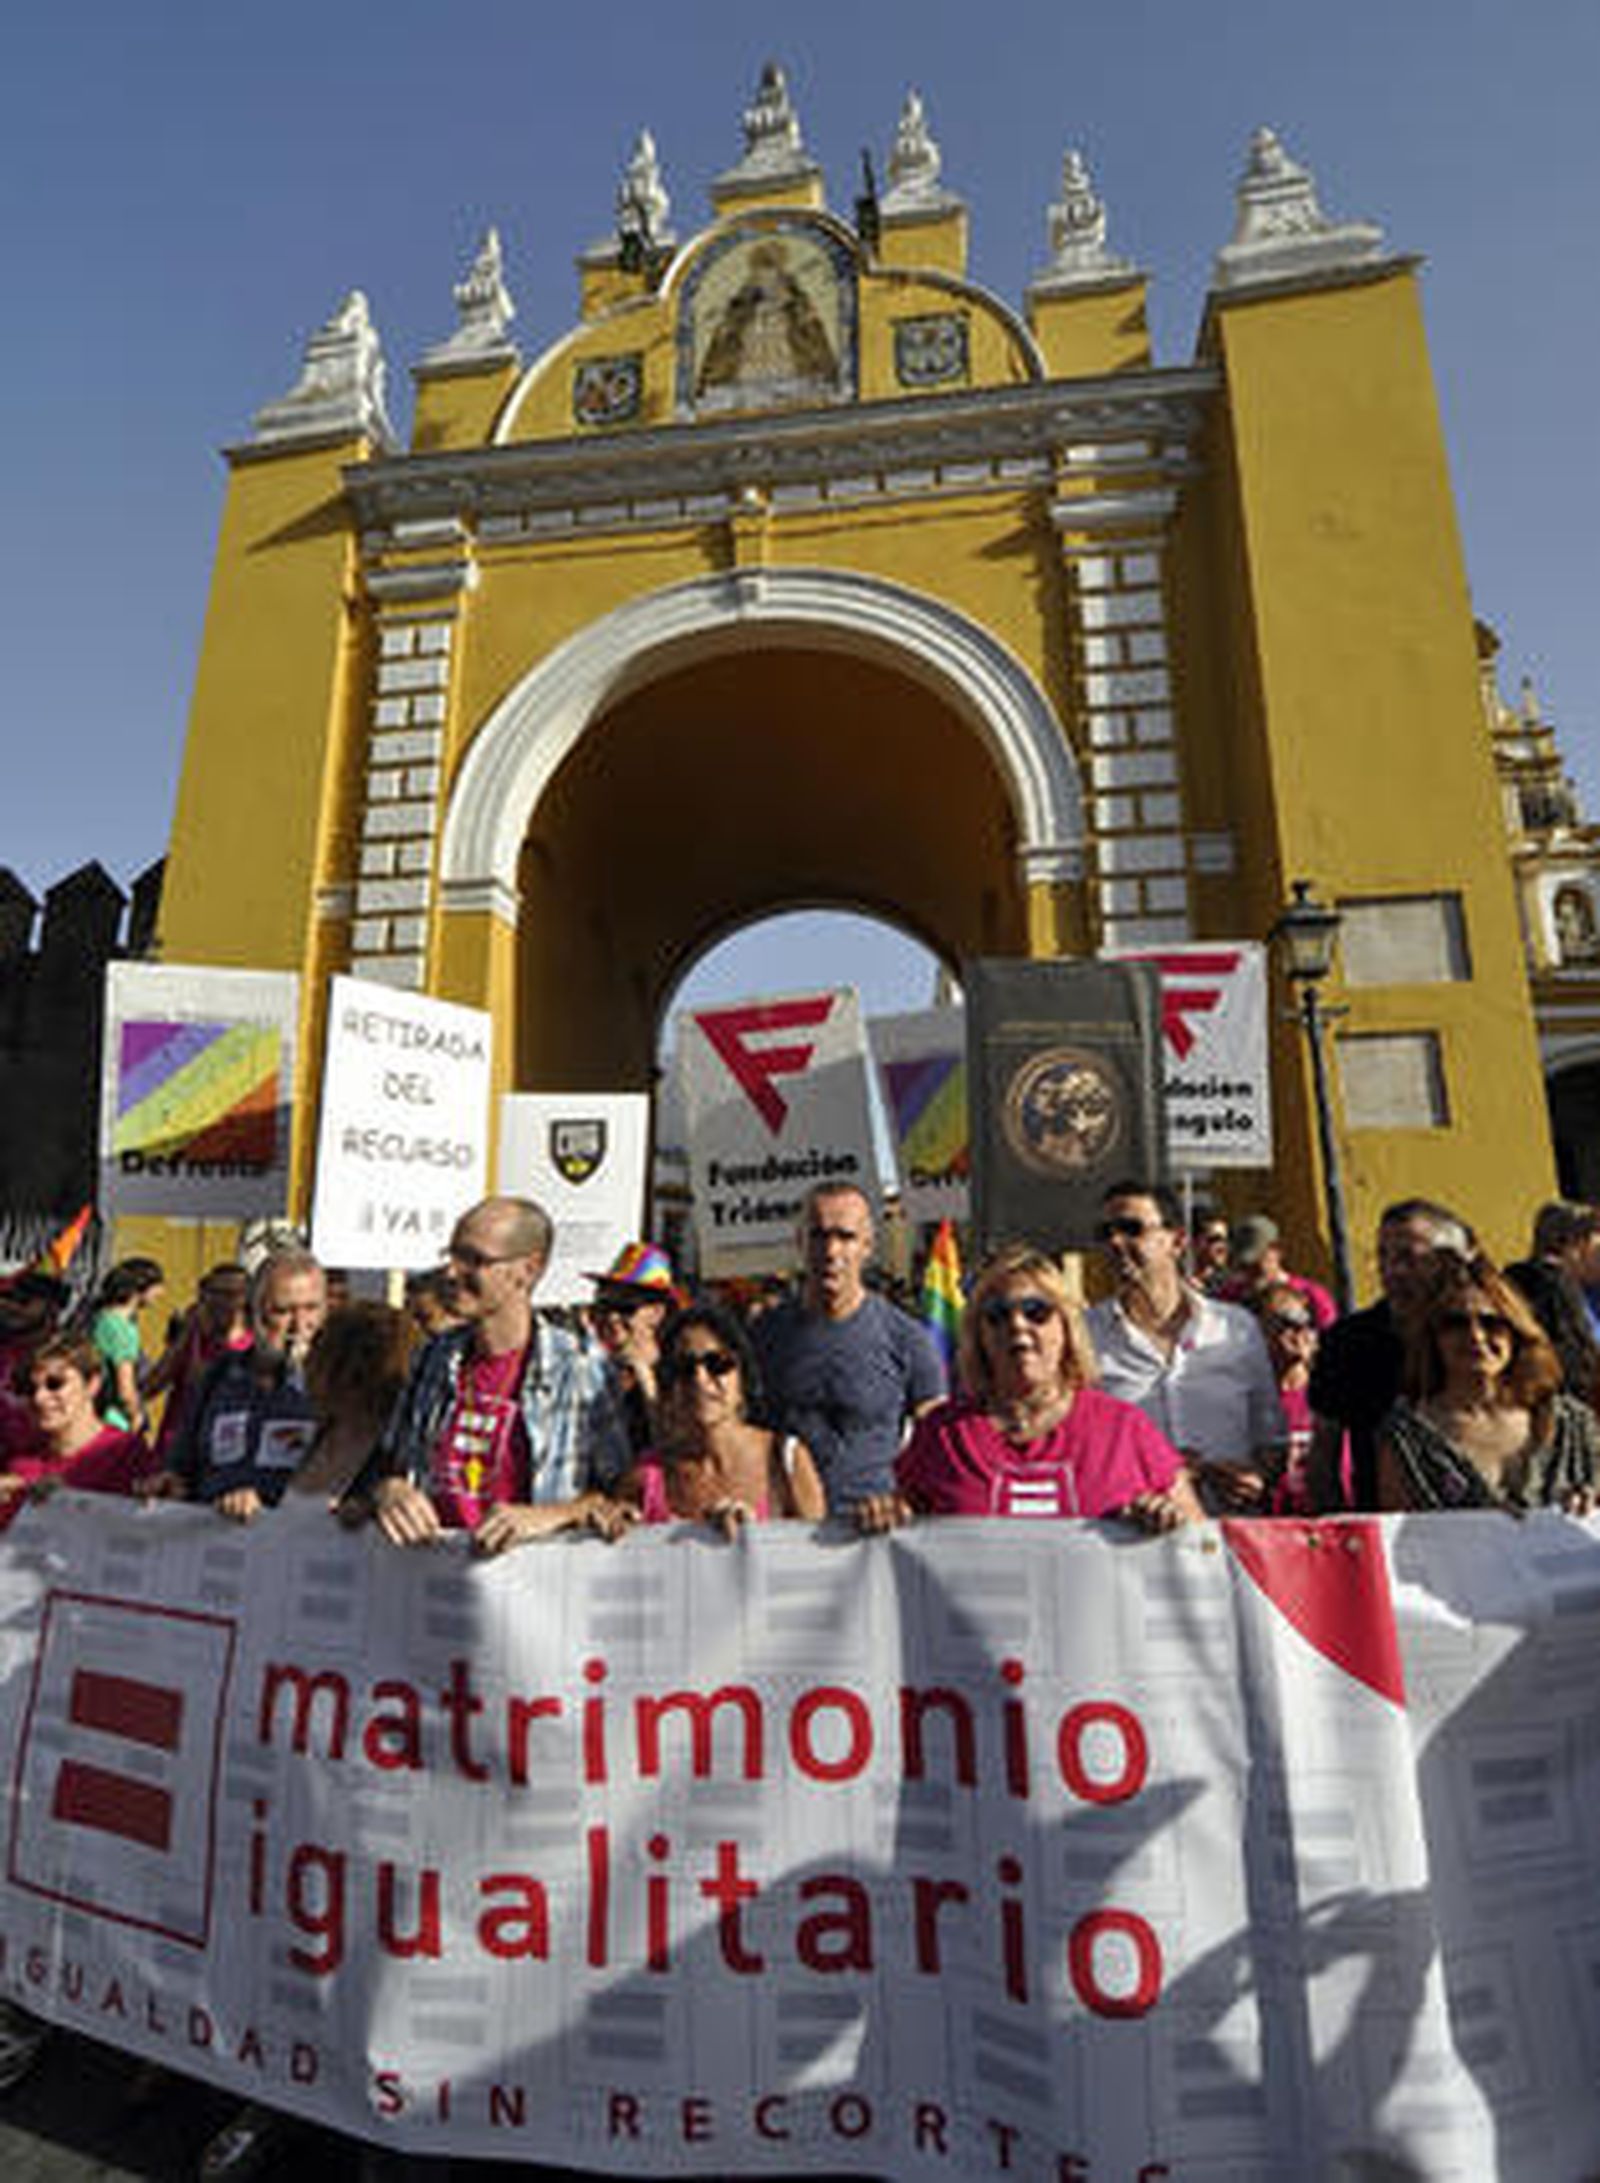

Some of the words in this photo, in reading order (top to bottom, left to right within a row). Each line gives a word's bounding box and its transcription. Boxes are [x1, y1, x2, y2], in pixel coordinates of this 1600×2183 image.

[342, 1006, 486, 1063] RETIRADA
[382, 1069, 436, 1106] DEL
[342, 1126, 476, 1170] RECURSO
[259, 1655, 1150, 1809] matrimonio
[247, 1800, 1167, 2019] igualitario
[376, 2071, 525, 2128] SIN
